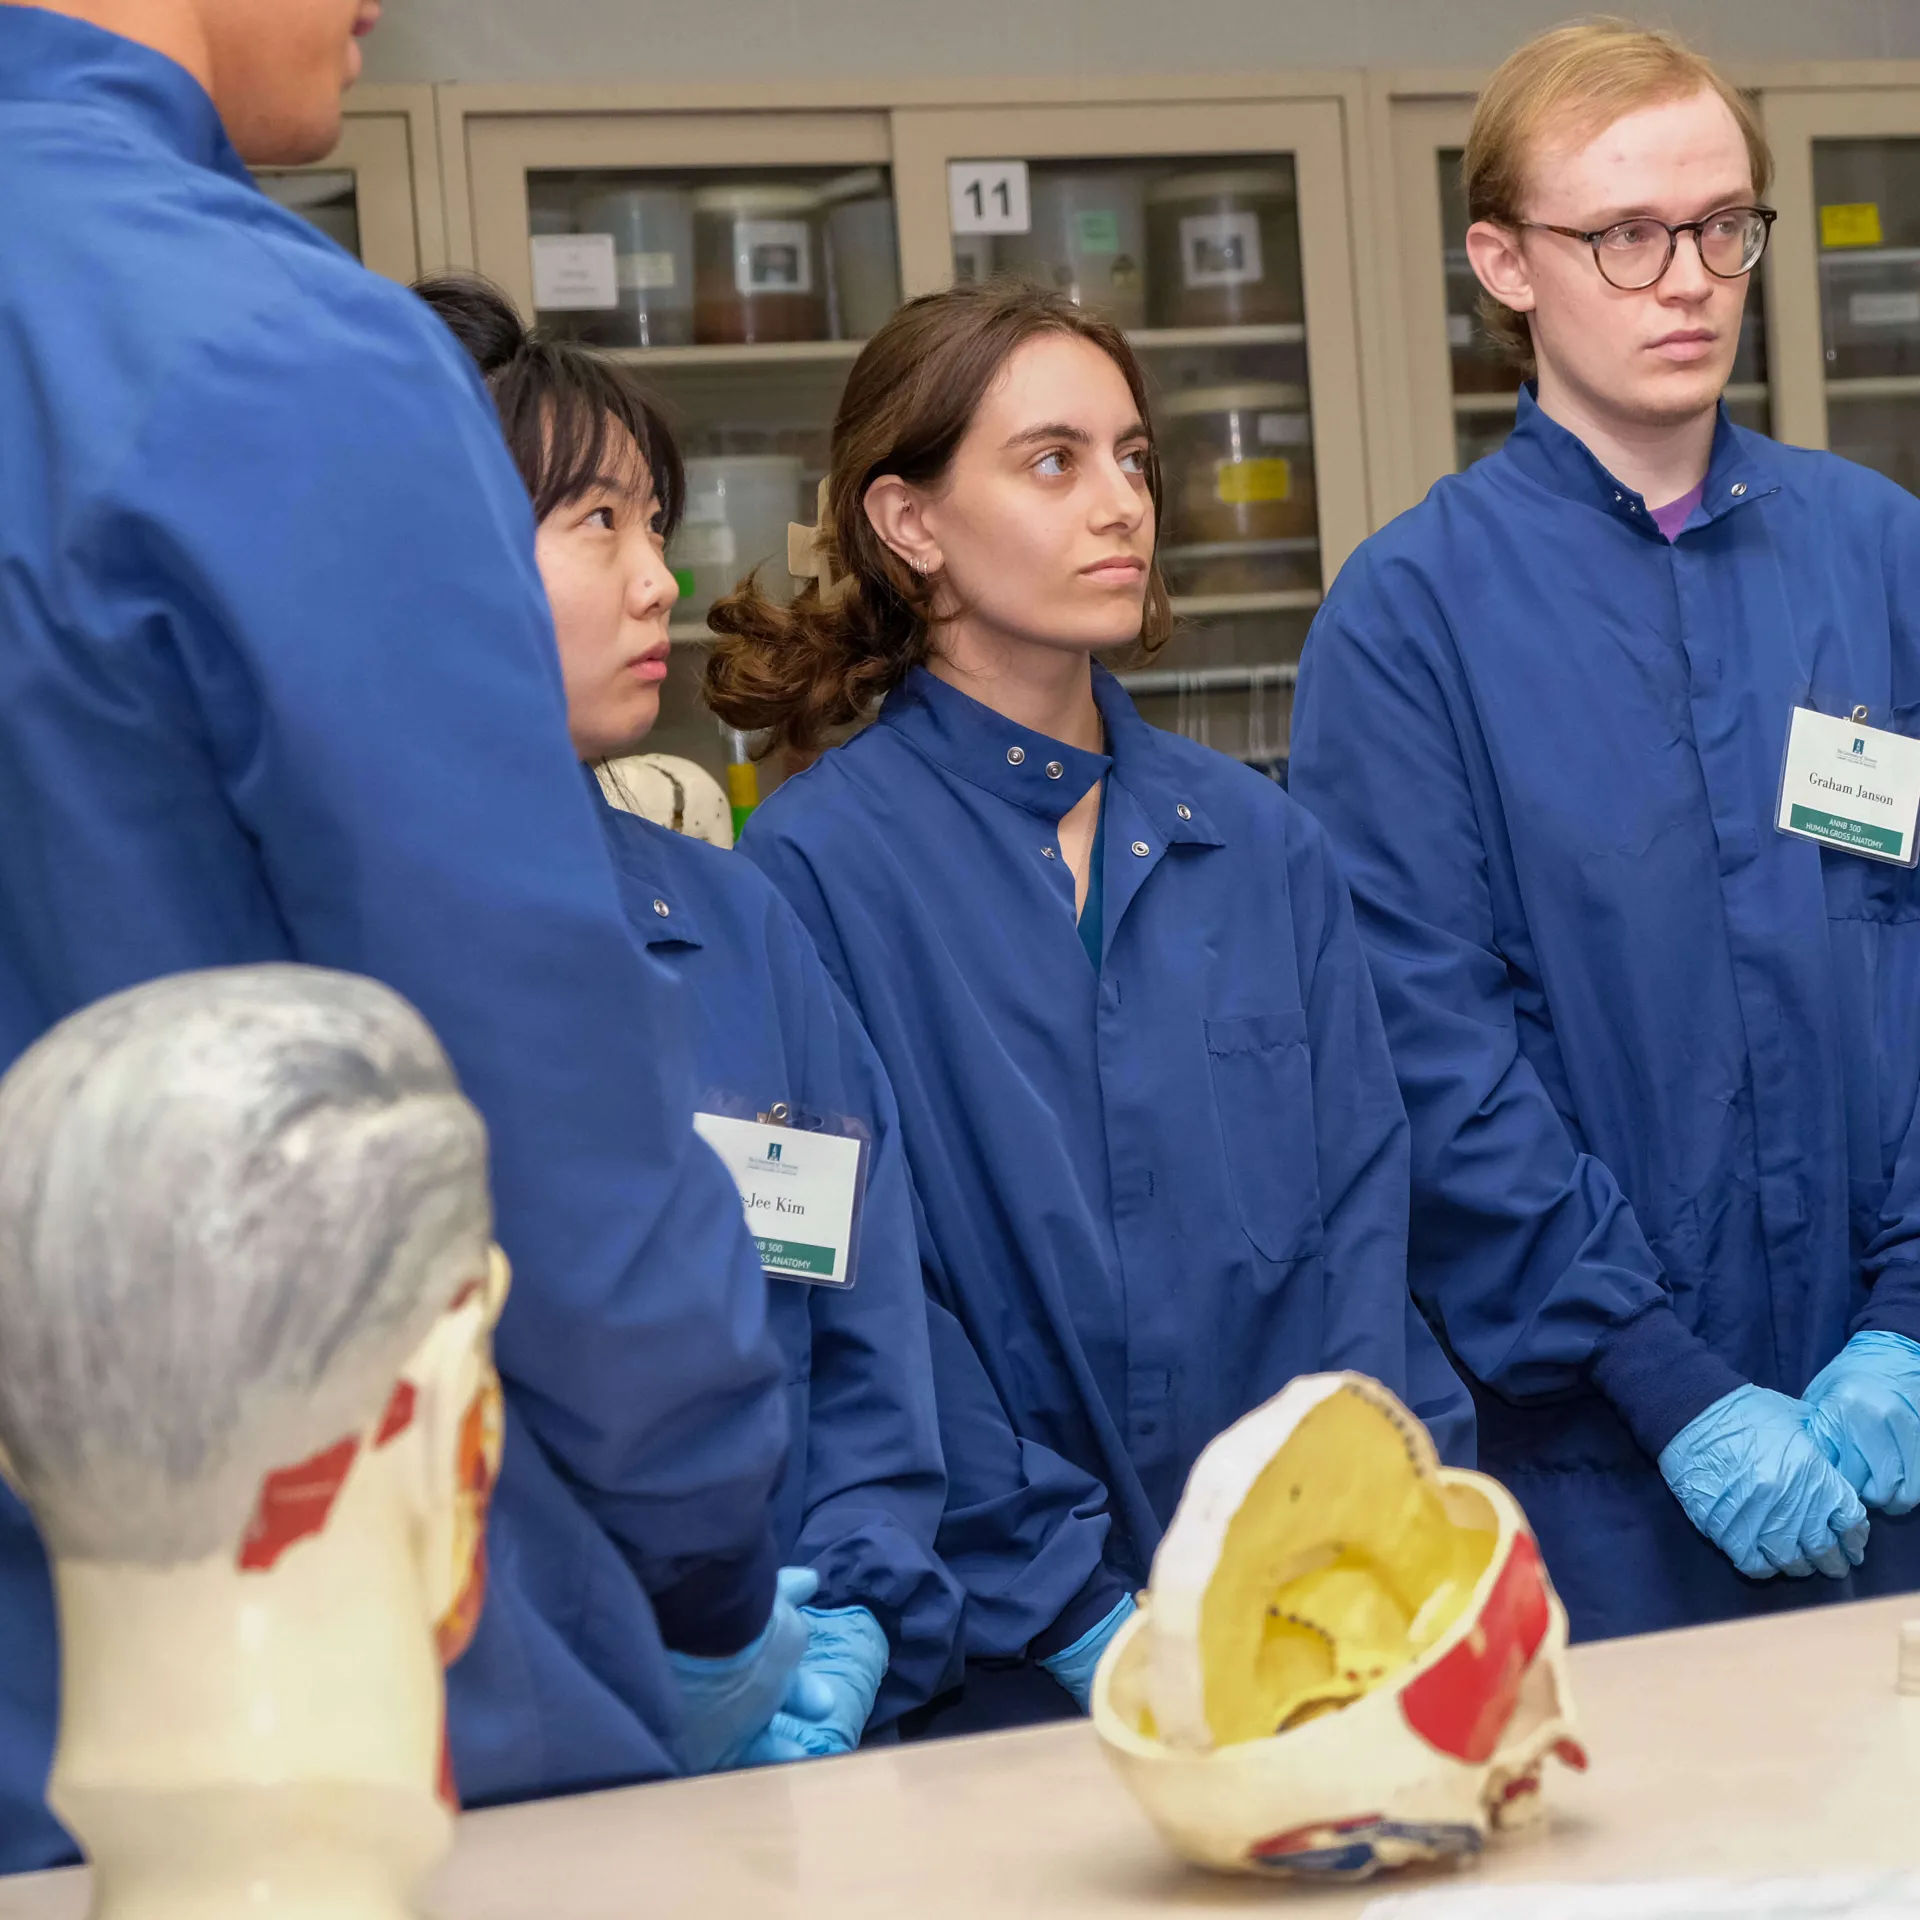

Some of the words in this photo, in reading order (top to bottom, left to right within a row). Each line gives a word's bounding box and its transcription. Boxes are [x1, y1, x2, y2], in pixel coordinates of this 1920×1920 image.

[963, 178, 1011, 219] 11
[1809, 772, 1853, 795] Graham
[1856, 785, 1894, 806] Janson
[1829, 818, 1848, 830] ANNB
[1849, 823, 1862, 833] 300
[1806, 822, 1829, 835] HUMAN
[1829, 829, 1851, 841] GROSS
[1851, 835, 1884, 849] ANATOMY
[776, 1196, 805, 1215] Kim
[768, 1243, 783, 1253] 300
[771, 1256, 811, 1269] ANATOMY
